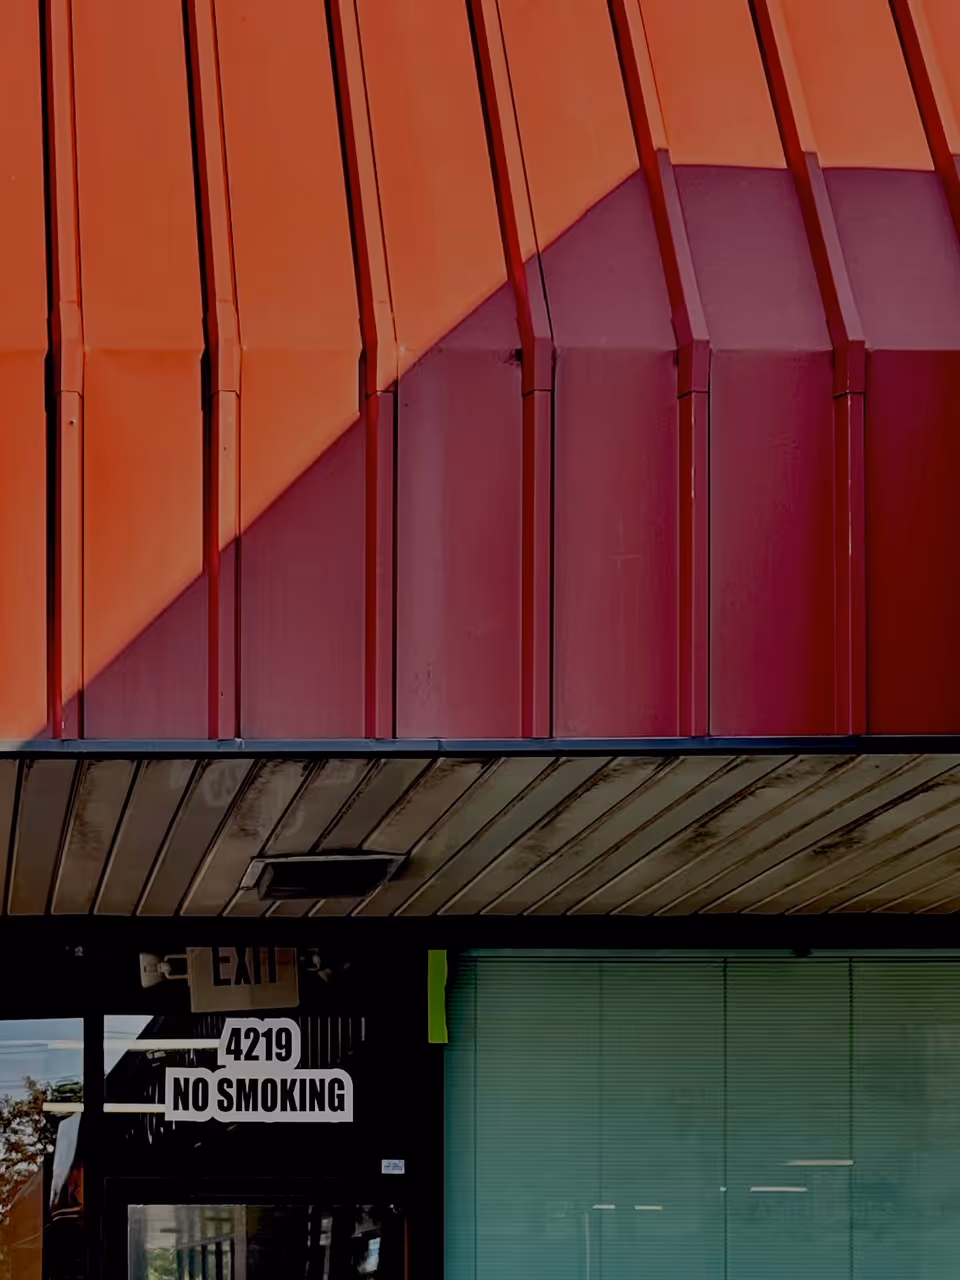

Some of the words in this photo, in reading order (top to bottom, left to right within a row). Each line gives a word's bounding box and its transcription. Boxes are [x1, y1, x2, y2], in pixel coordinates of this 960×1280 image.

[225, 1027, 293, 1062] 4219
[172, 1077, 209, 1112] NO
[217, 1077, 345, 1113] SMOKING
